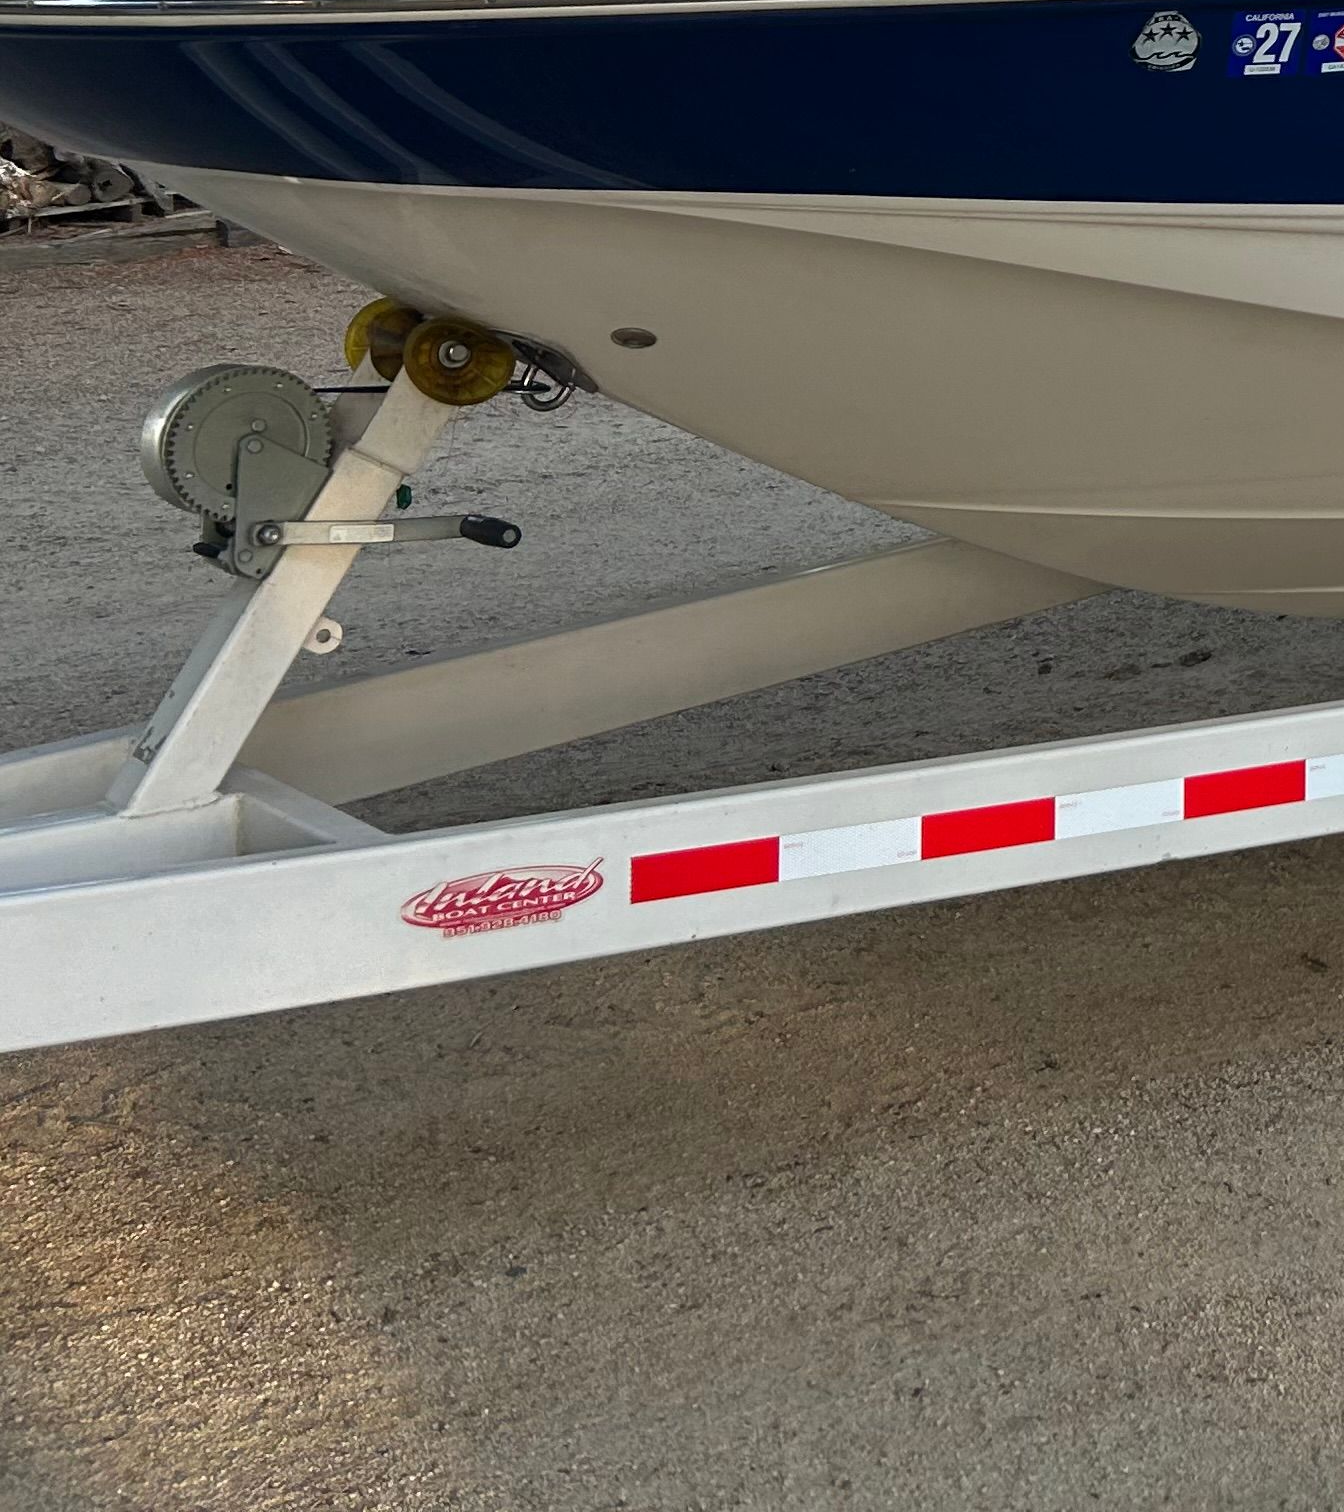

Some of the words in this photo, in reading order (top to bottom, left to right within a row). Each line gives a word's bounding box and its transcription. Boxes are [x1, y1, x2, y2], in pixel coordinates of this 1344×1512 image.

[1245, 12, 1295, 22] CALIFORNIA
[1252, 22, 1302, 64] 27
[414, 856, 604, 915] Inland
[432, 905, 490, 923] BOAT
[497, 890, 577, 912] CENTER
